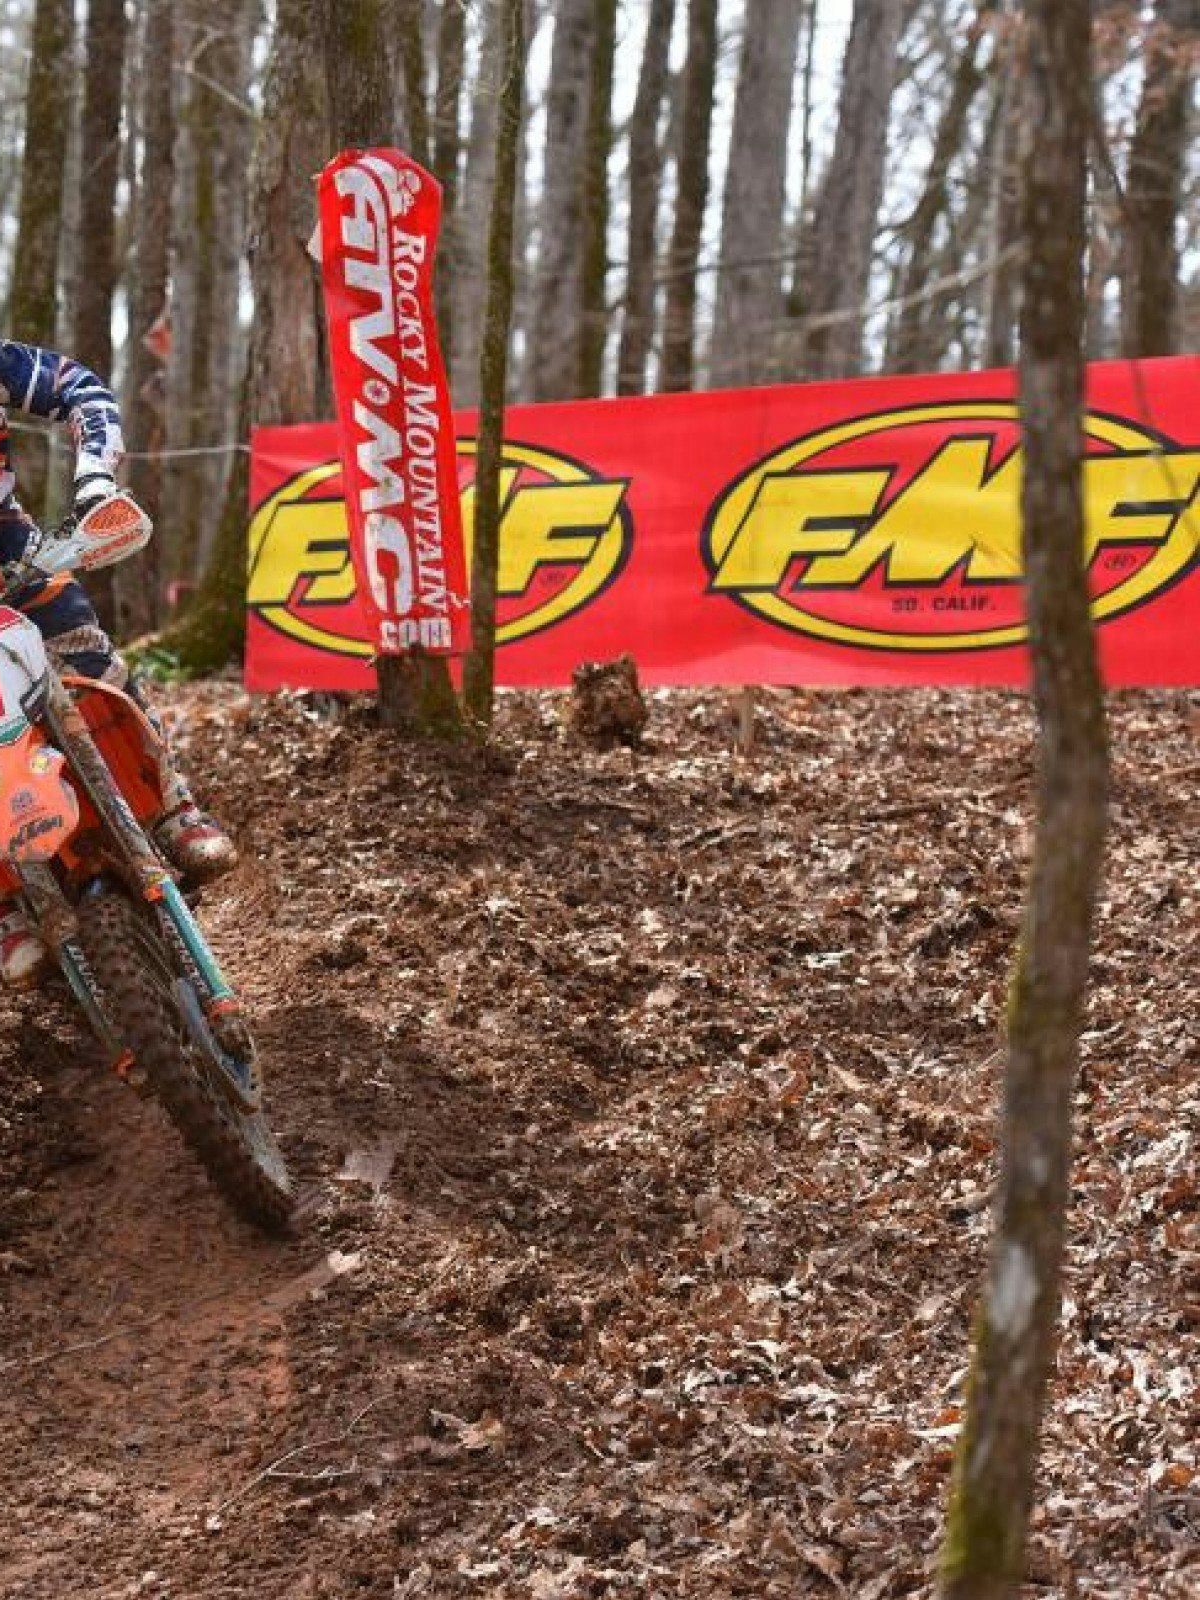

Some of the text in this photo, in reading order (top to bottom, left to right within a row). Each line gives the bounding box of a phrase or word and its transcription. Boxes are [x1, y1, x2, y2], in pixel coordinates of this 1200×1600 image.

[392, 226, 448, 614] ROCKY MOUNTAIN
[933, 594, 997, 611] CALIF.
